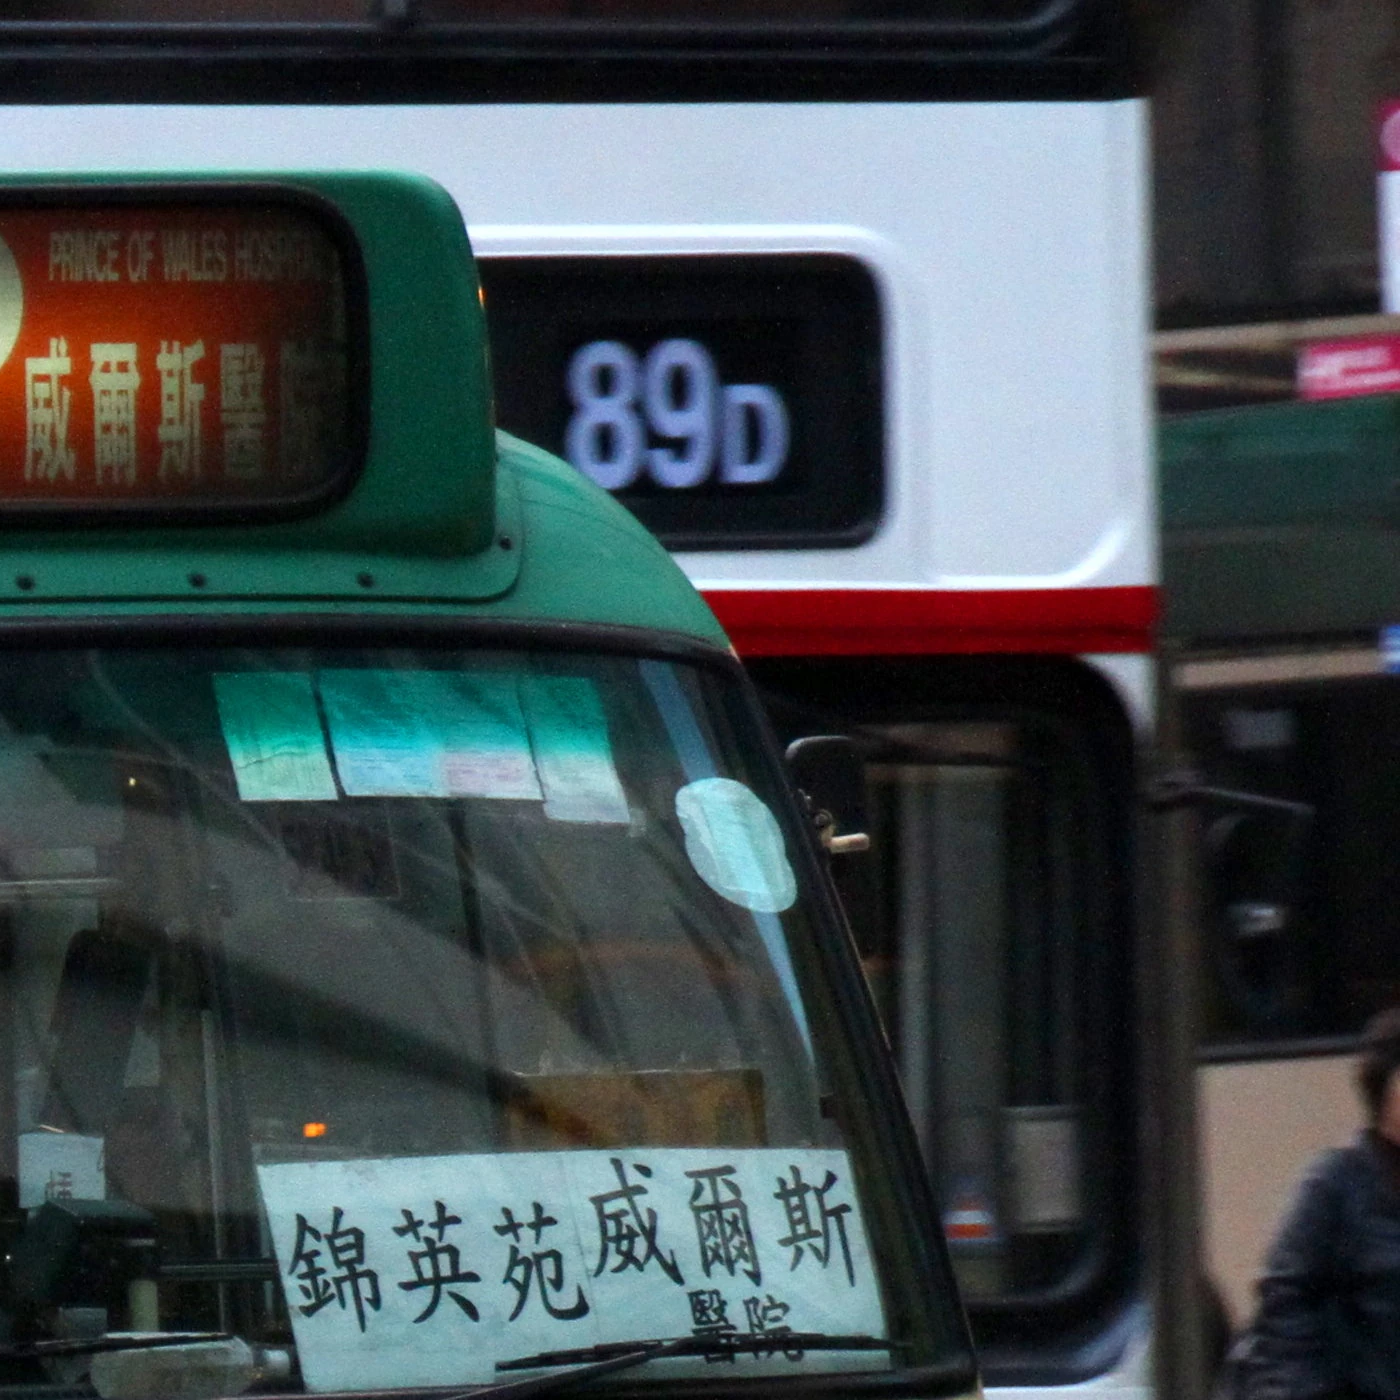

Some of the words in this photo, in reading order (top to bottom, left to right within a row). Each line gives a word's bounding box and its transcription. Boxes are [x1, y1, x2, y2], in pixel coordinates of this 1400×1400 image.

[49, 229, 121, 282] PRINCE
[127, 229, 156, 283] OF
[159, 229, 228, 282] WALES
[566, 337, 791, 491] 89D
